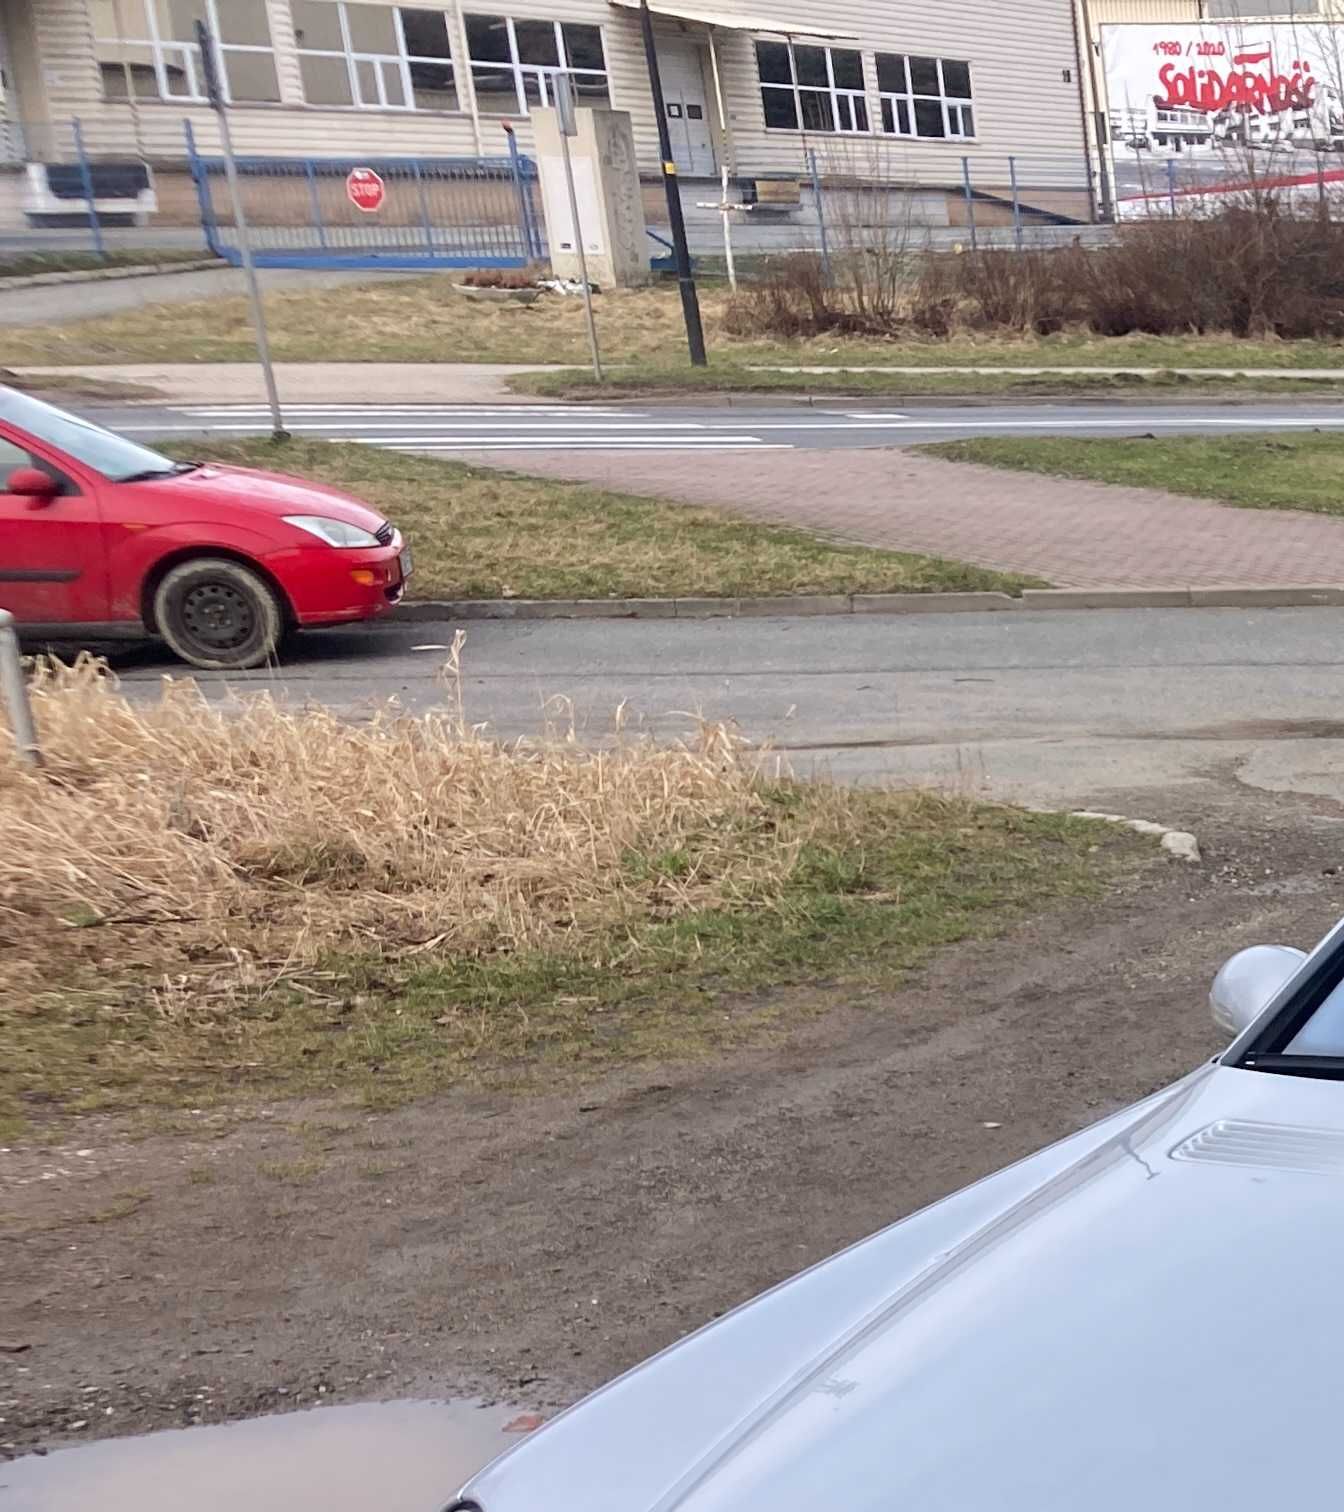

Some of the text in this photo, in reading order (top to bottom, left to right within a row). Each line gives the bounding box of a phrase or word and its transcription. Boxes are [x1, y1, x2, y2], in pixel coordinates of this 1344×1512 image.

[1152, 41, 1182, 56] 1980
[1195, 41, 1226, 56] 2020
[351, 182, 380, 197] STOP
